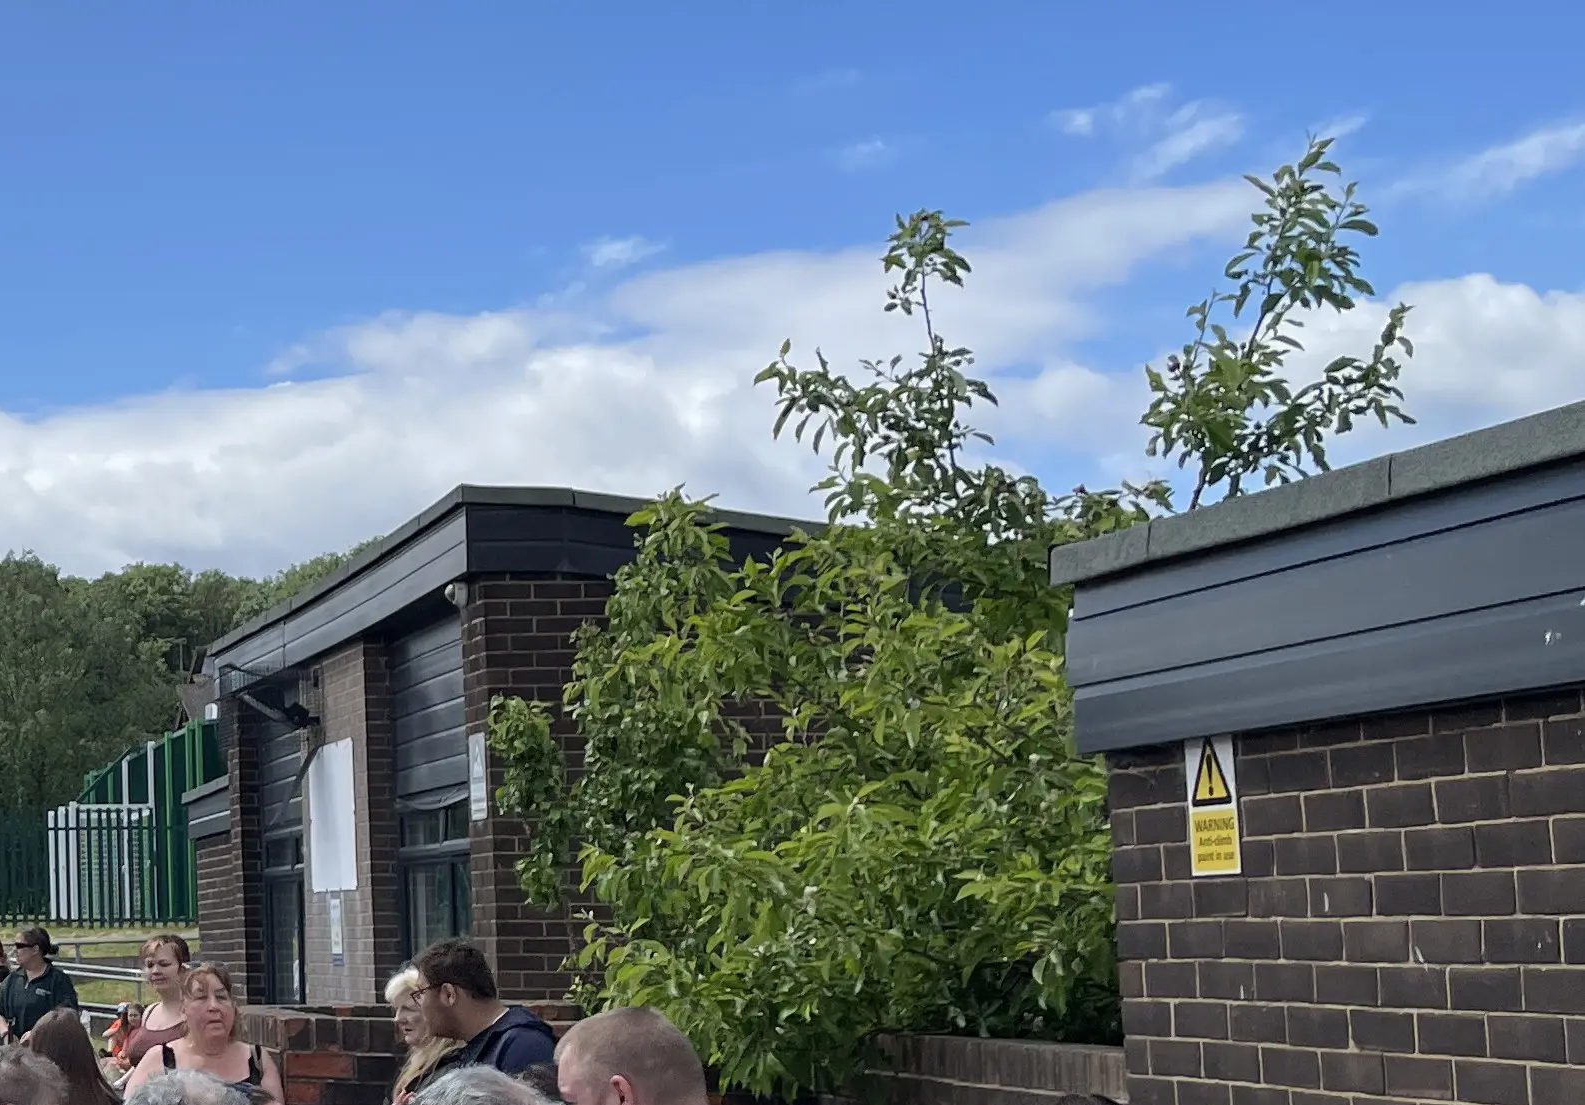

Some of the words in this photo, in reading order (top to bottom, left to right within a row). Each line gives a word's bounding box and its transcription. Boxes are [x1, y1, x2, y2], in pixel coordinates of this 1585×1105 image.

[1194, 816, 1235, 832] WARNING
[1199, 833, 1233, 847] Anti-climb
[1197, 852, 1214, 864] paint
[1215, 850, 1222, 861] in
[1223, 851, 1235, 861] use
